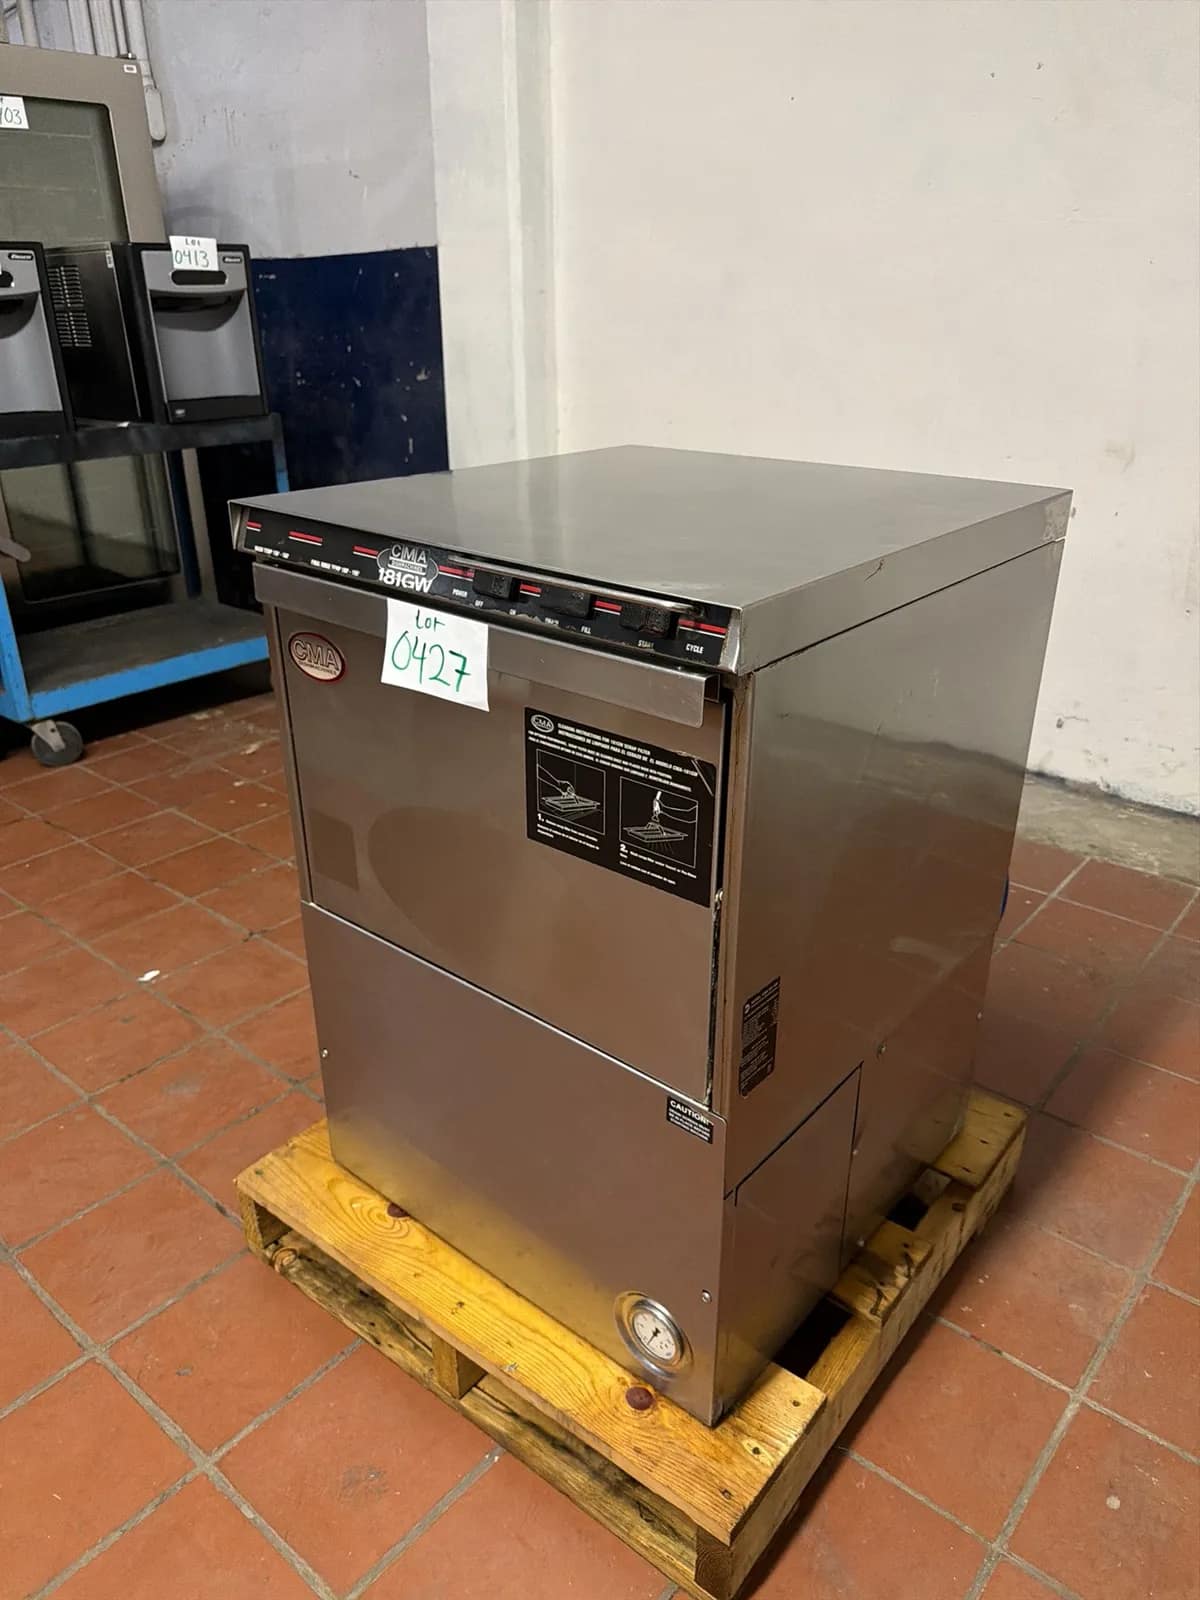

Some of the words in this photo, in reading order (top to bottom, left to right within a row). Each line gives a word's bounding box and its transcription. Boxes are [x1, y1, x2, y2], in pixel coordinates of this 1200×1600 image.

[174, 249, 210, 268] 0413
[391, 544, 427, 564] CMA
[378, 568, 433, 593] 181GW
[293, 638, 340, 672] CMA
[685, 643, 704, 654] CYCLE
[391, 630, 472, 693] 0427
